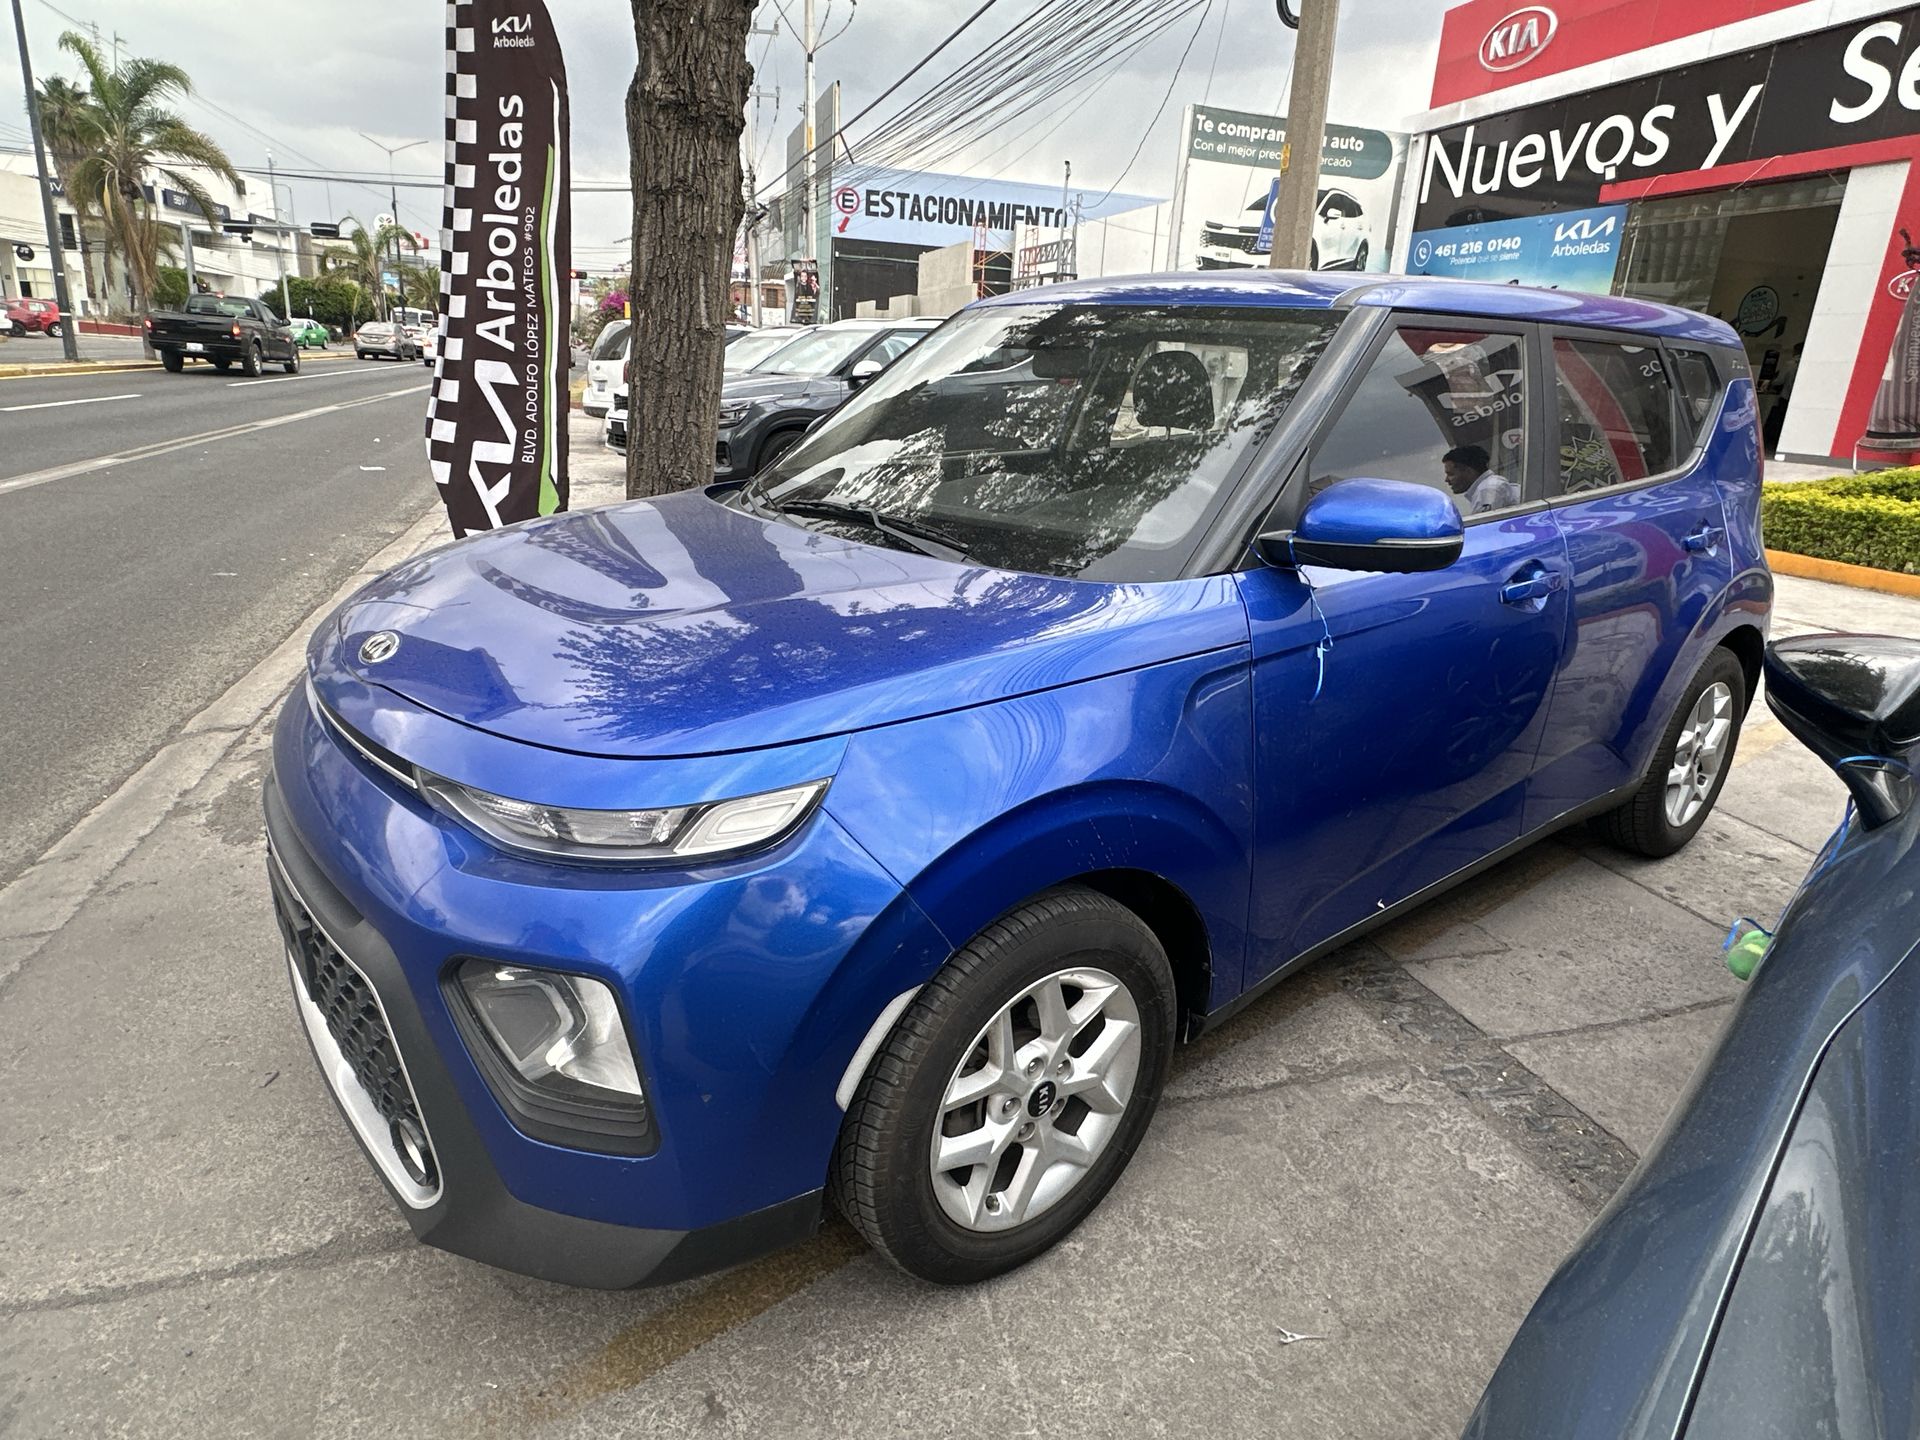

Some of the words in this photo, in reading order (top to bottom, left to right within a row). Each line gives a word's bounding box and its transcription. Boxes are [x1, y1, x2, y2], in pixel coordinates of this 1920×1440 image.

[1488, 17, 1538, 61] KIA
[1196, 113, 1214, 133] Te
[1330, 136, 1364, 151] auto
[1420, 104, 1676, 204] Nuevos
[1700, 83, 1764, 170] y
[1193, 138, 1214, 151] Con
[1216, 142, 1226, 153] el
[1228, 145, 1257, 158] mejor
[1320, 156, 1352, 168] ercado
[475, 94, 525, 352] Arboledas
[524, 206, 536, 241] #902
[865, 189, 1067, 231] ESTACIONAMIENTO
[1434, 243, 1457, 257] 461
[1460, 241, 1483, 255] 216
[1487, 236, 1521, 252] 0140
[1551, 240, 1610, 257] Arboledas
[522, 246, 537, 308] MATEOS
[523, 313, 539, 359] LÓPEZ
[525, 362, 539, 423] ADOLFO
[522, 427, 538, 464] BLVD.
[1039, 1086, 1049, 1115] KIA
